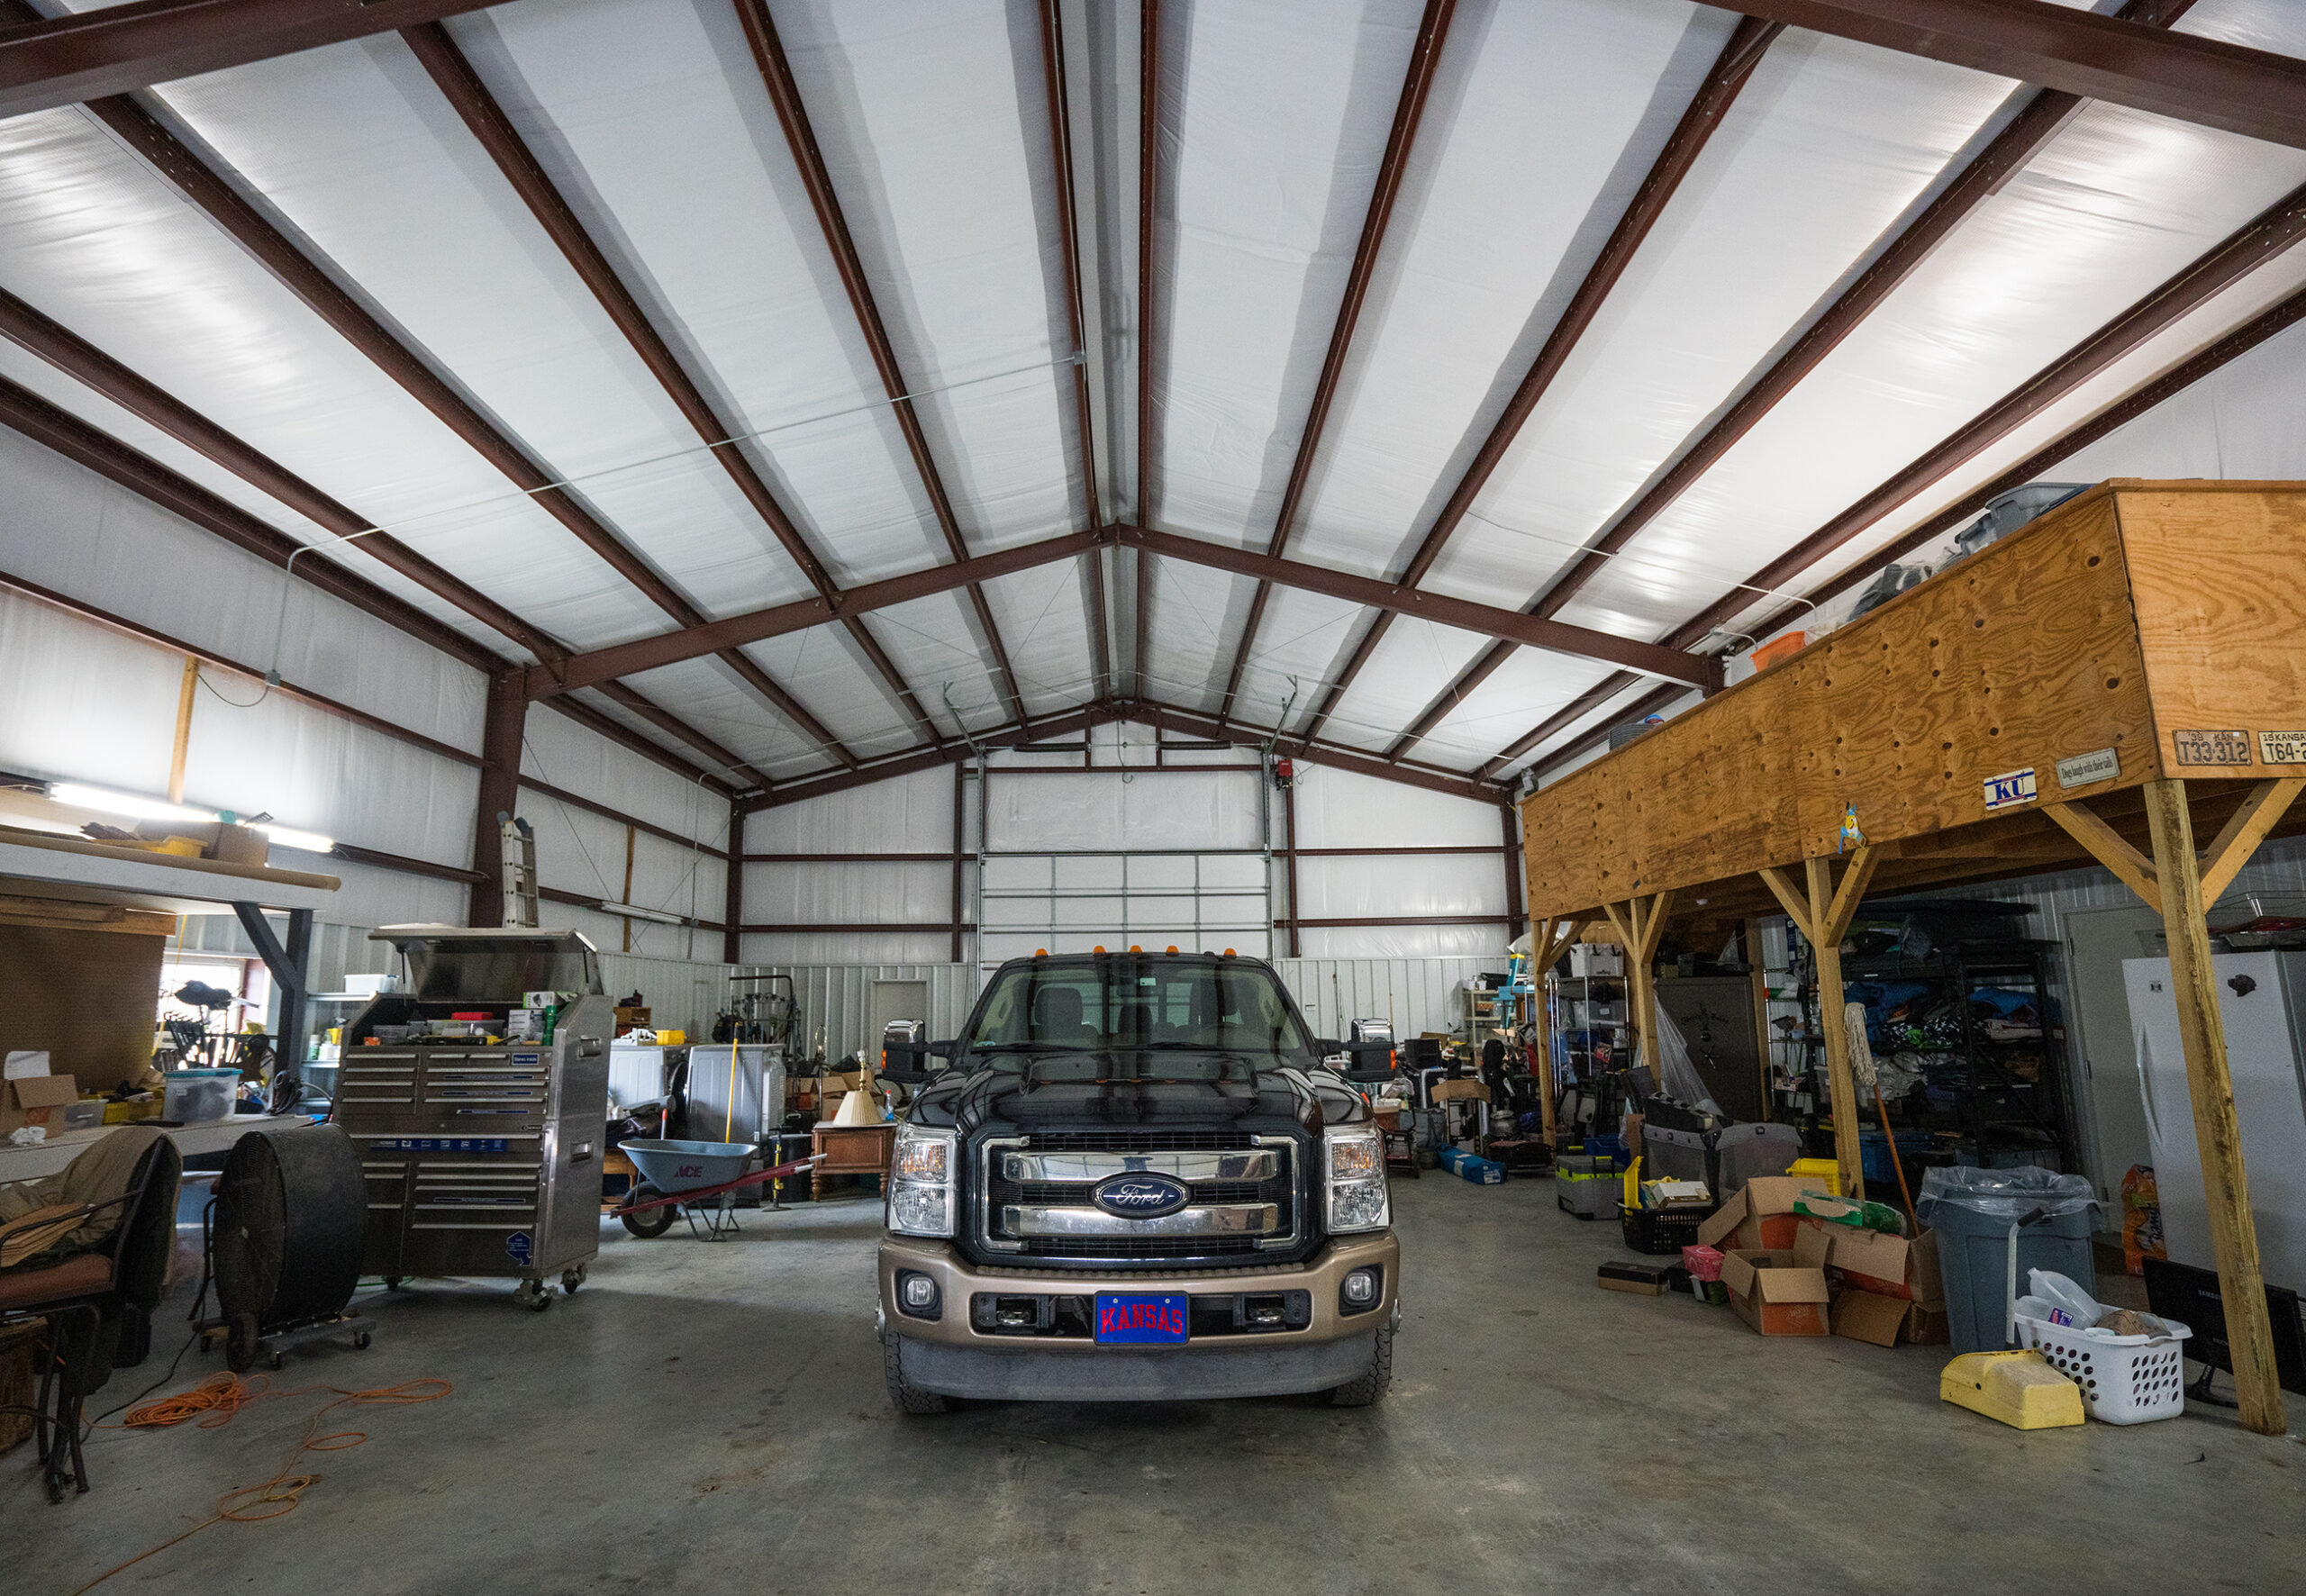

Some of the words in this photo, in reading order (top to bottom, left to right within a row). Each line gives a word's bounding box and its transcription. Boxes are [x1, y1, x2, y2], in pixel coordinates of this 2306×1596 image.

[1994, 776, 2025, 801] KU
[674, 1165, 704, 1178] ACE
[1116, 1183, 1166, 1205] Ford
[1101, 1303, 1183, 1334] KANSAS
